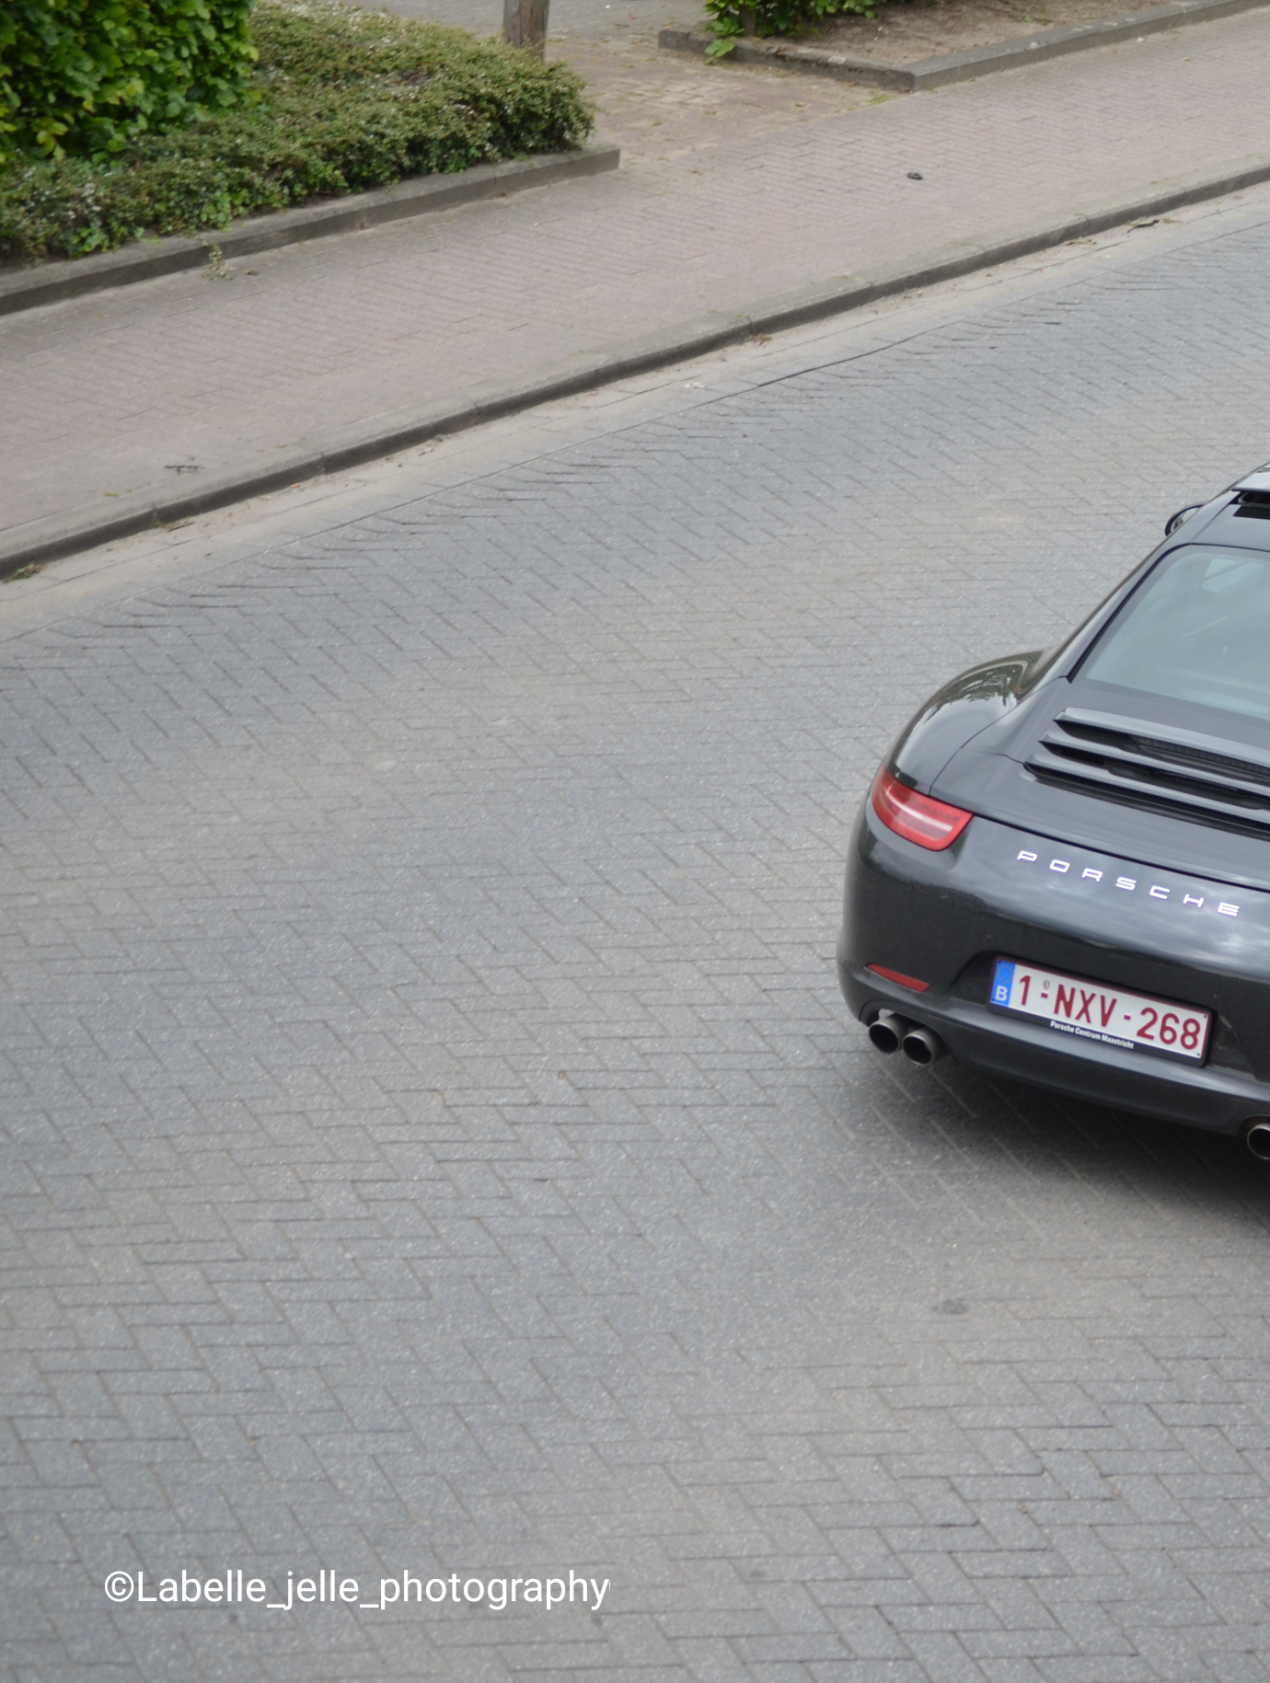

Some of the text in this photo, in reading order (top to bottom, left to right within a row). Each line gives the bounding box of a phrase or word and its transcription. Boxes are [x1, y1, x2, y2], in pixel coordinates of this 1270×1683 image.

[1017, 850, 1240, 917] PORSCHE
[995, 985, 1008, 1002] B
[1050, 1020, 1134, 1049] Porsche Centrum Maastricht
